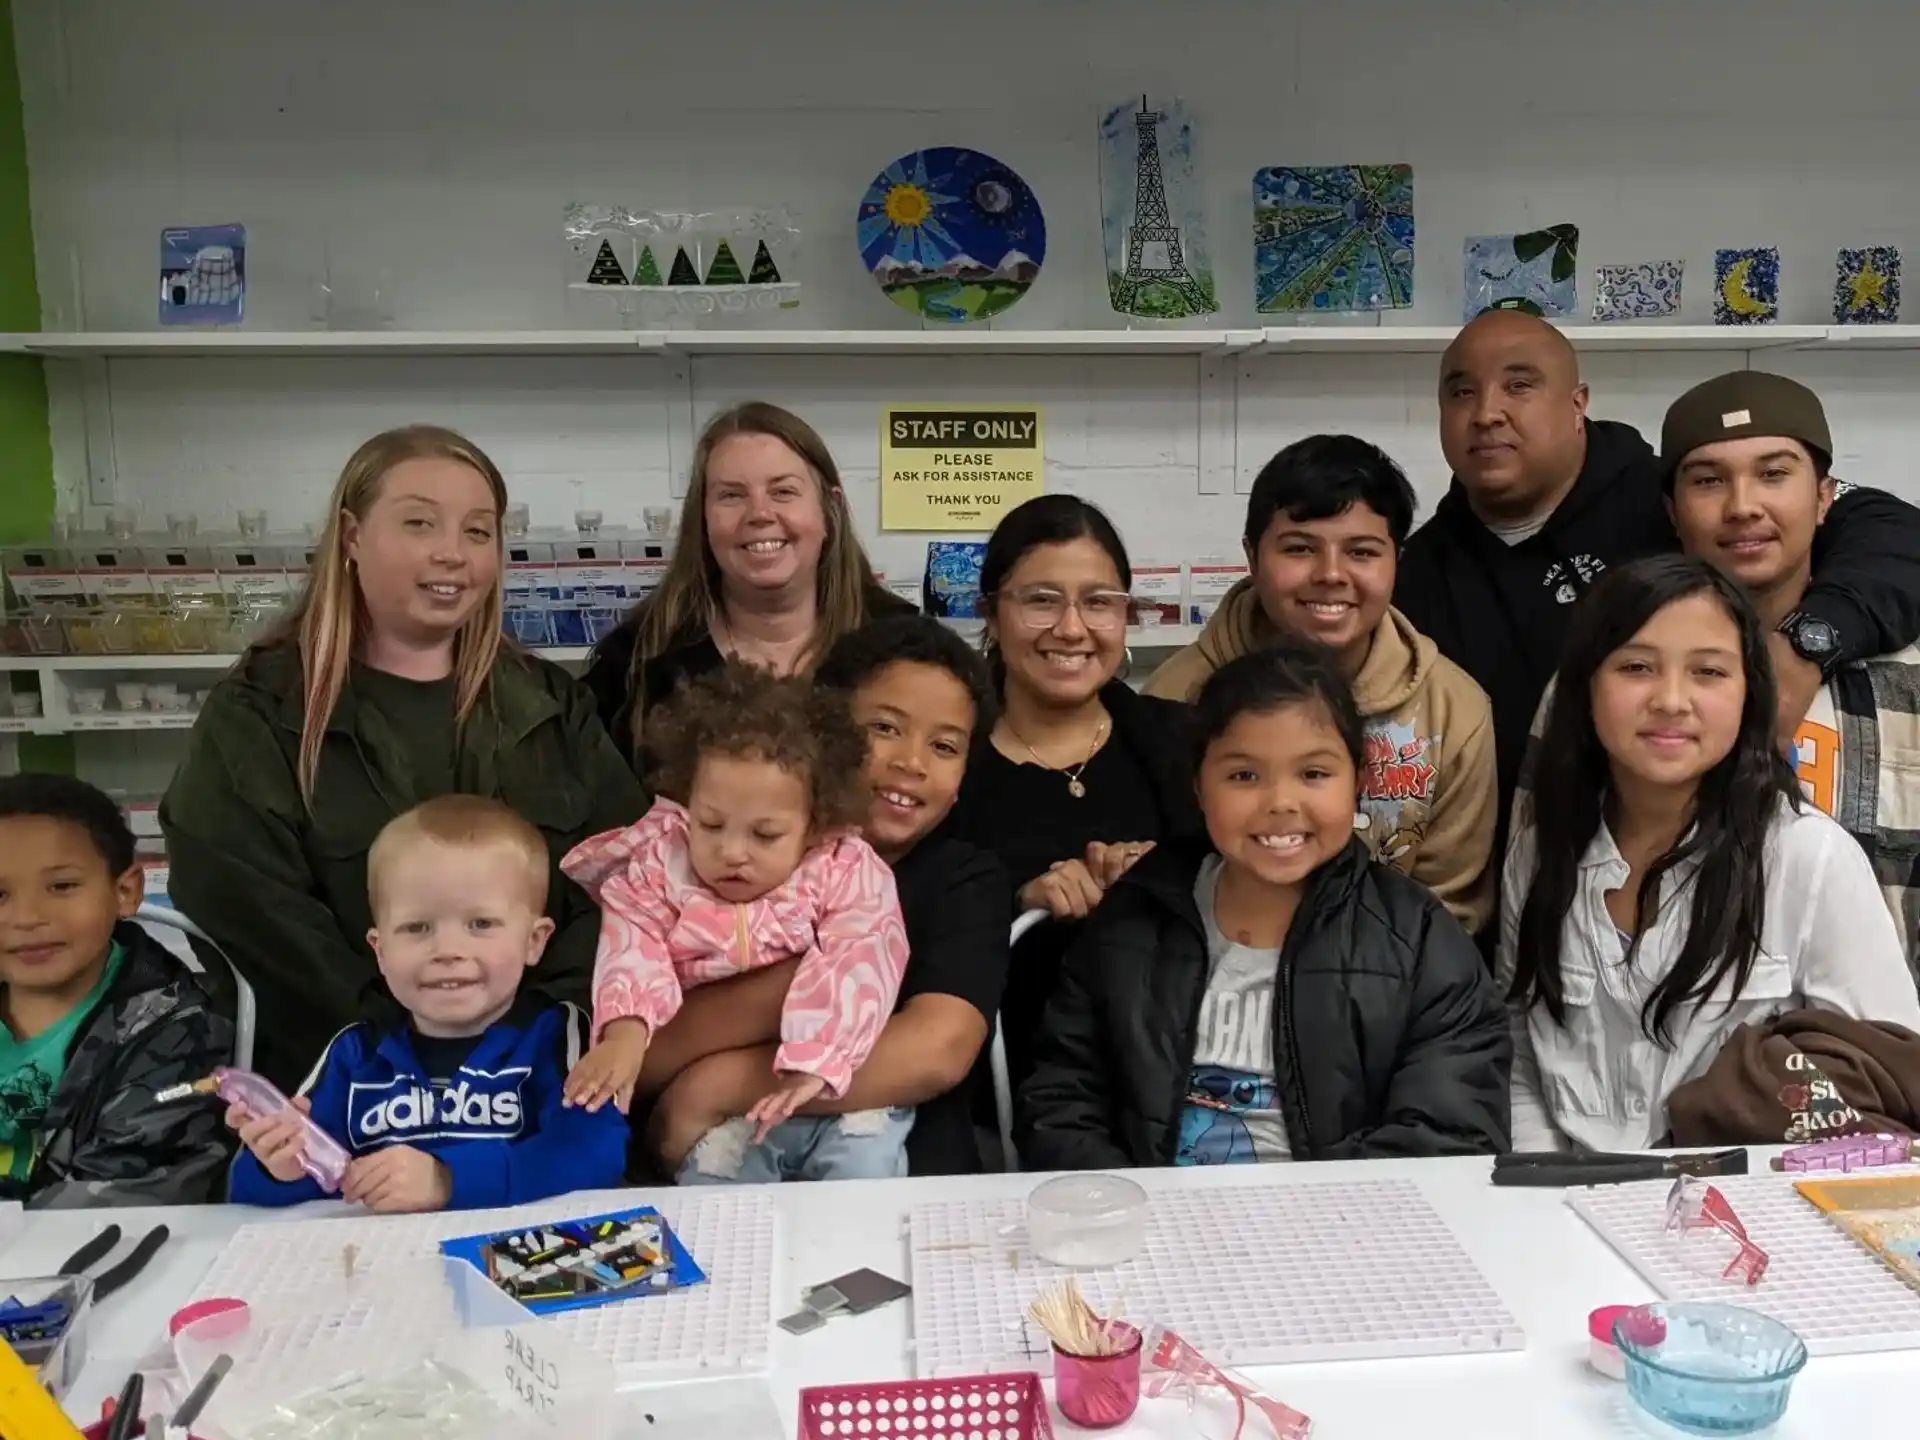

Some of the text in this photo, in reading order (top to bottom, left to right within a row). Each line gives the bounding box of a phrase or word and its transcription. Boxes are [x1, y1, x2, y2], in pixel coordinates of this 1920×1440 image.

[893, 420, 1034, 440] STAFF ONLY
[934, 453, 993, 466] PLEASE
[893, 471, 1034, 482] ASK FOR ASSISTANCE
[926, 495, 1001, 505] THANK YOU
[1358, 763, 1437, 799] ERRY
[361, 1081, 521, 1135] adidas
